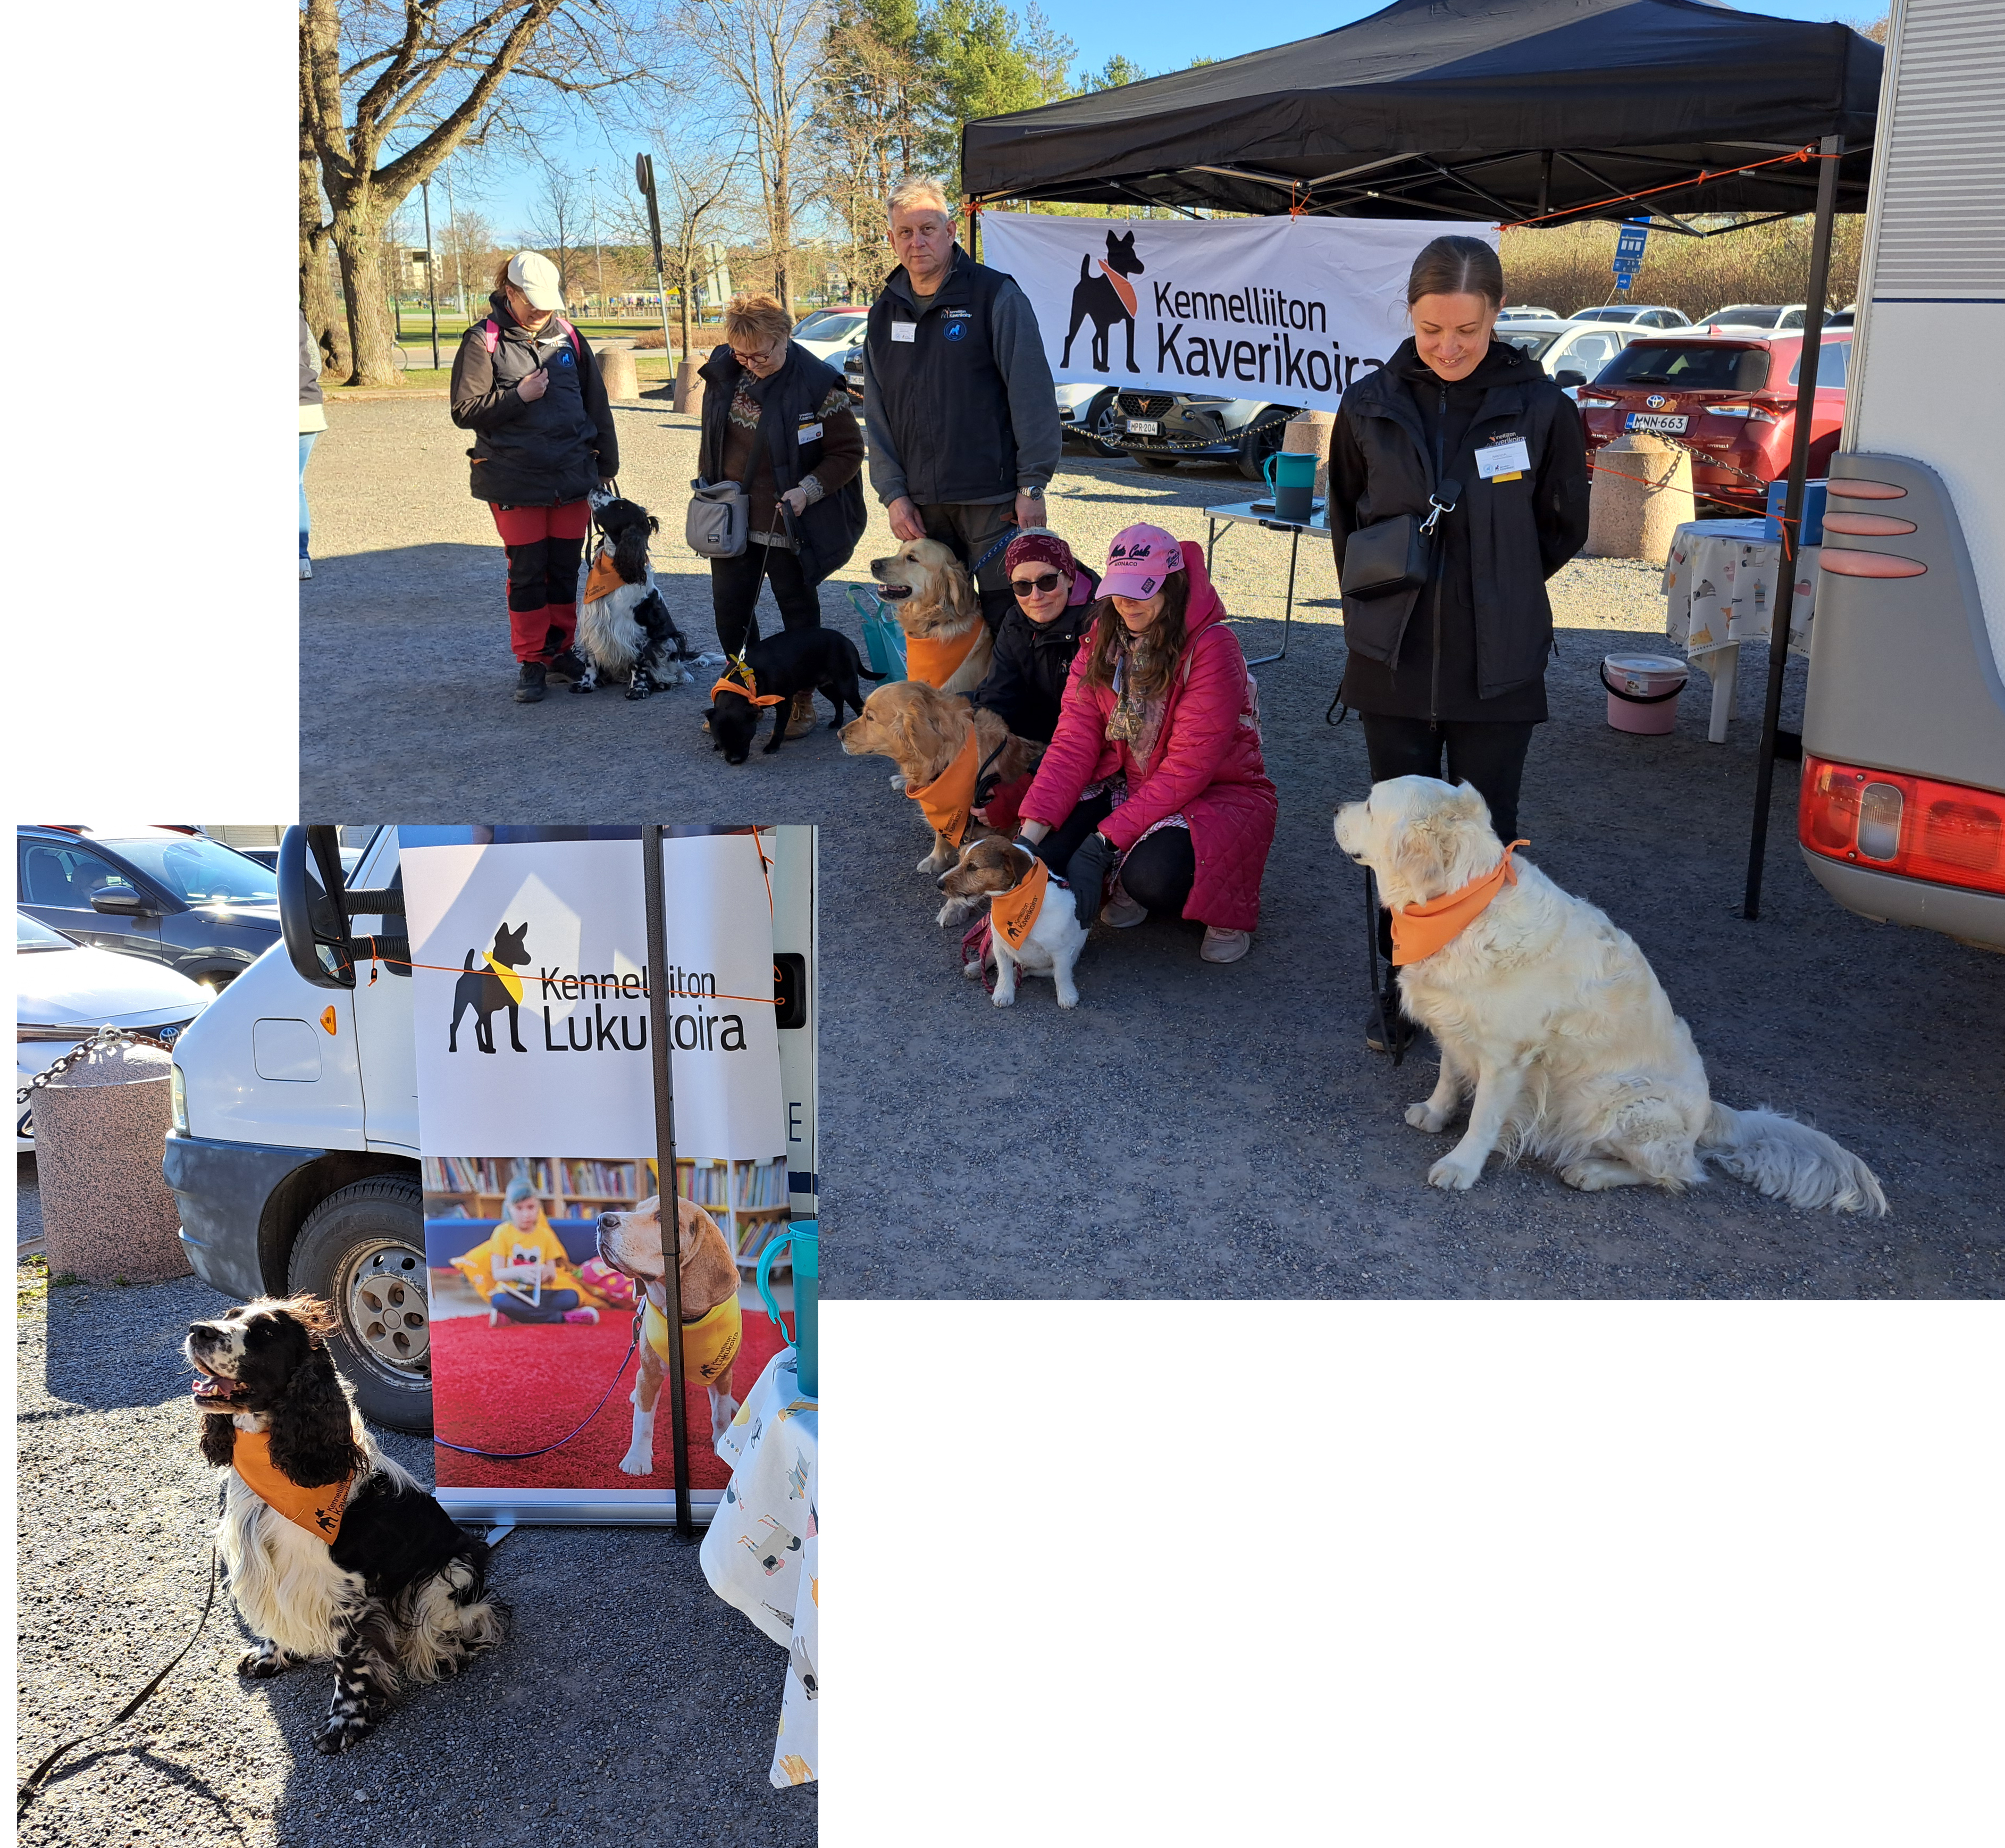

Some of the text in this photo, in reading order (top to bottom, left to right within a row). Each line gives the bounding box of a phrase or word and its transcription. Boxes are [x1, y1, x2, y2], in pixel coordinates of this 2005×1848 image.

[1153, 281, 1327, 333] Kennelliiton
[1131, 422, 1155, 432] MPR-204
[1634, 415, 1684, 429] MNN-663
[1018, 897, 1038, 930] Kaverikoira
[541, 965, 716, 1000] Kenneliton
[711, 1335, 732, 1365] Kennelliiton
[715, 1332, 738, 1366] Lukukoira
